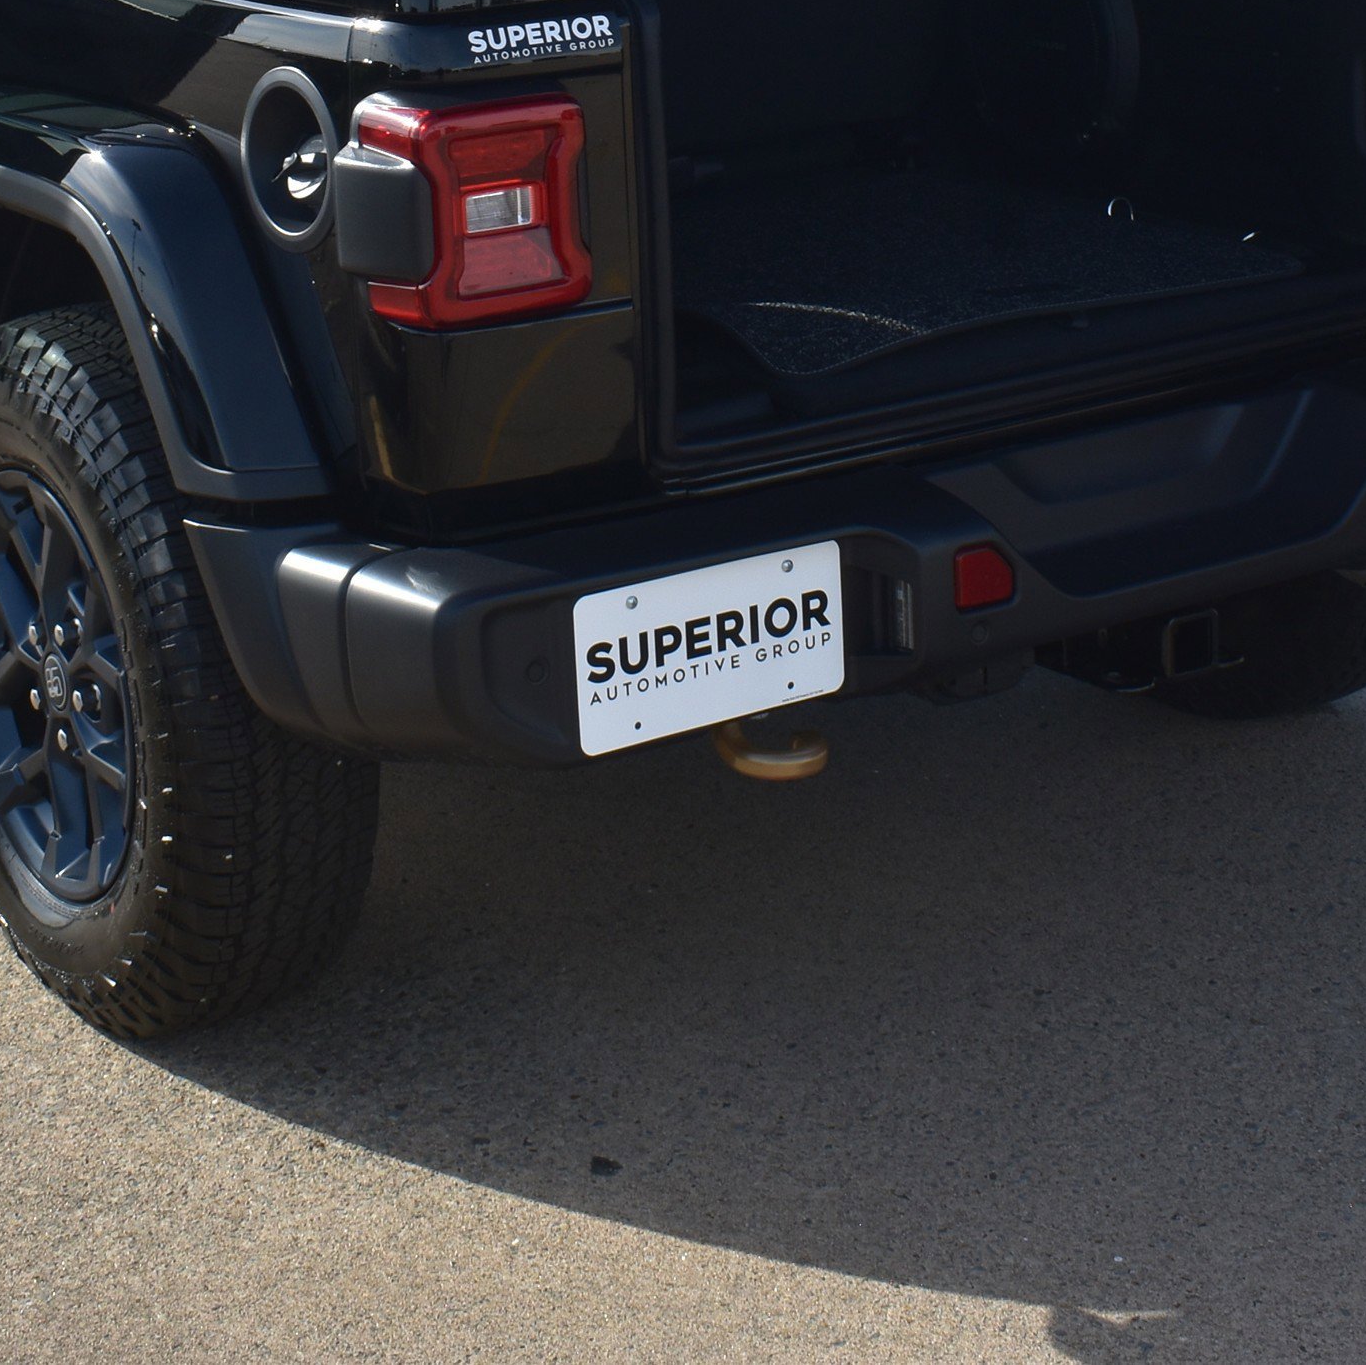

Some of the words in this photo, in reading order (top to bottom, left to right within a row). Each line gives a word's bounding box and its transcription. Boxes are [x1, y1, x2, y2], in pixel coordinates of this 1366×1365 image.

[468, 15, 613, 53] SUPERIOR
[474, 44, 562, 64] AUTOMOTIVE
[569, 38, 615, 51] GROUP
[586, 589, 831, 684] SUPERIOR
[590, 654, 740, 706] AUTOMOTIVE
[755, 632, 831, 662] GROUP
